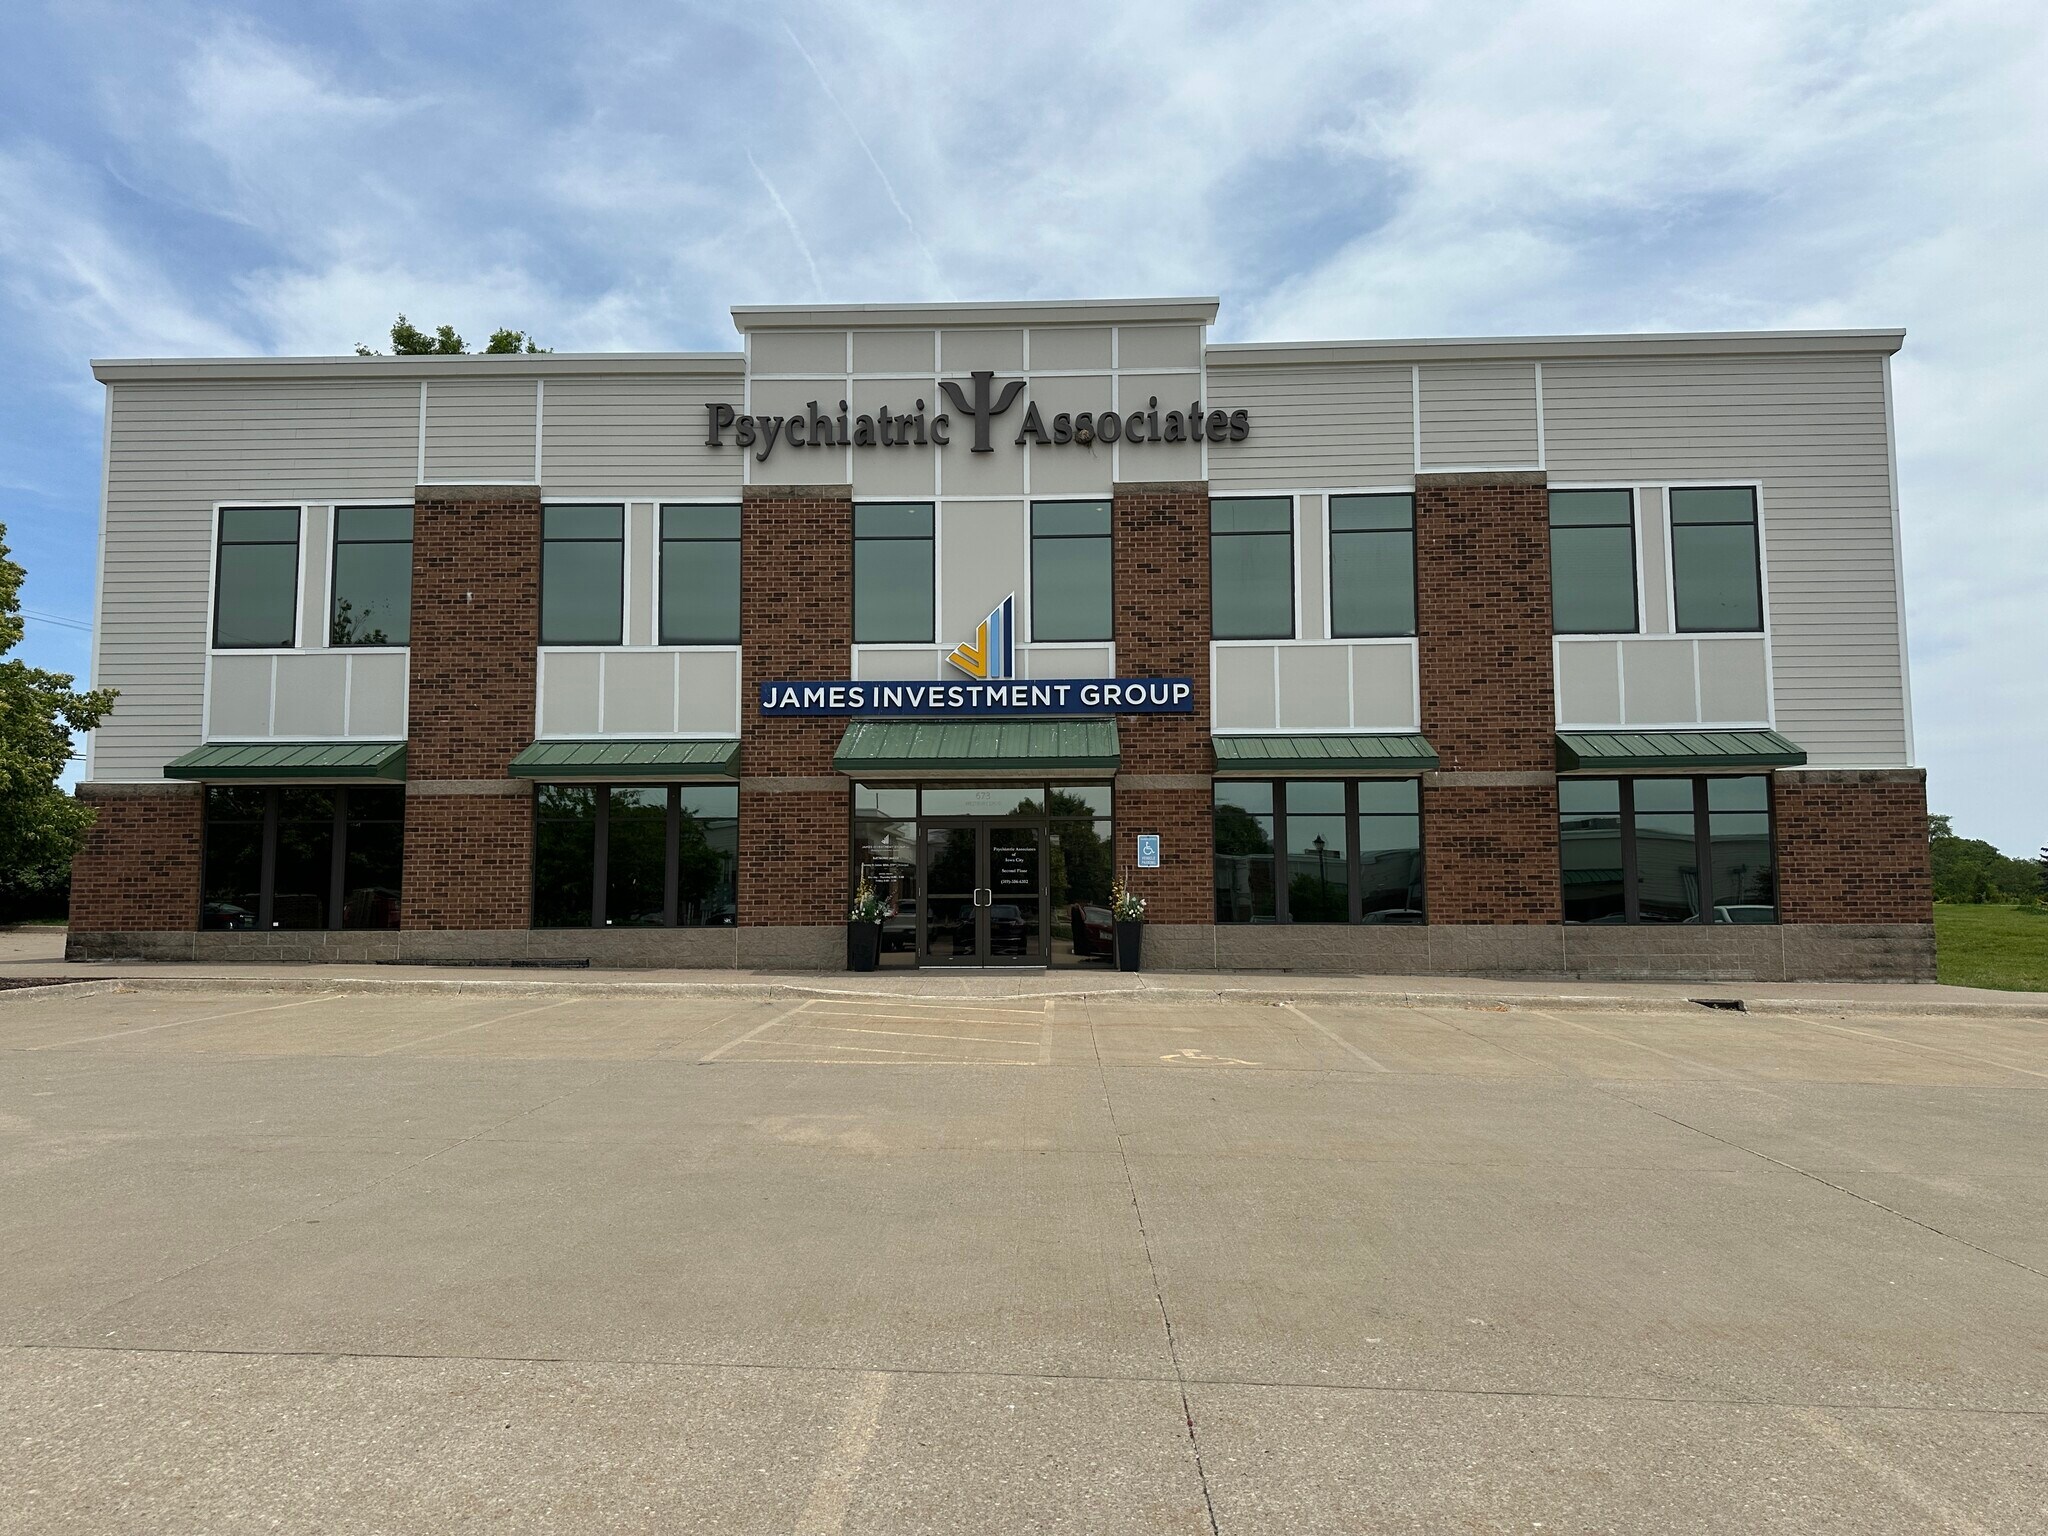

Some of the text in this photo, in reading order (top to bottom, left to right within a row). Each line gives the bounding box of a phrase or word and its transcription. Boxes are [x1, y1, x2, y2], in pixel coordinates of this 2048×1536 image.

[705, 398, 950, 462] Psychiatric
[1015, 395, 1250, 445] Associates
[763, 682, 1191, 709] JAMES INVESTMENT GROUP
[975, 791, 991, 800] 673
